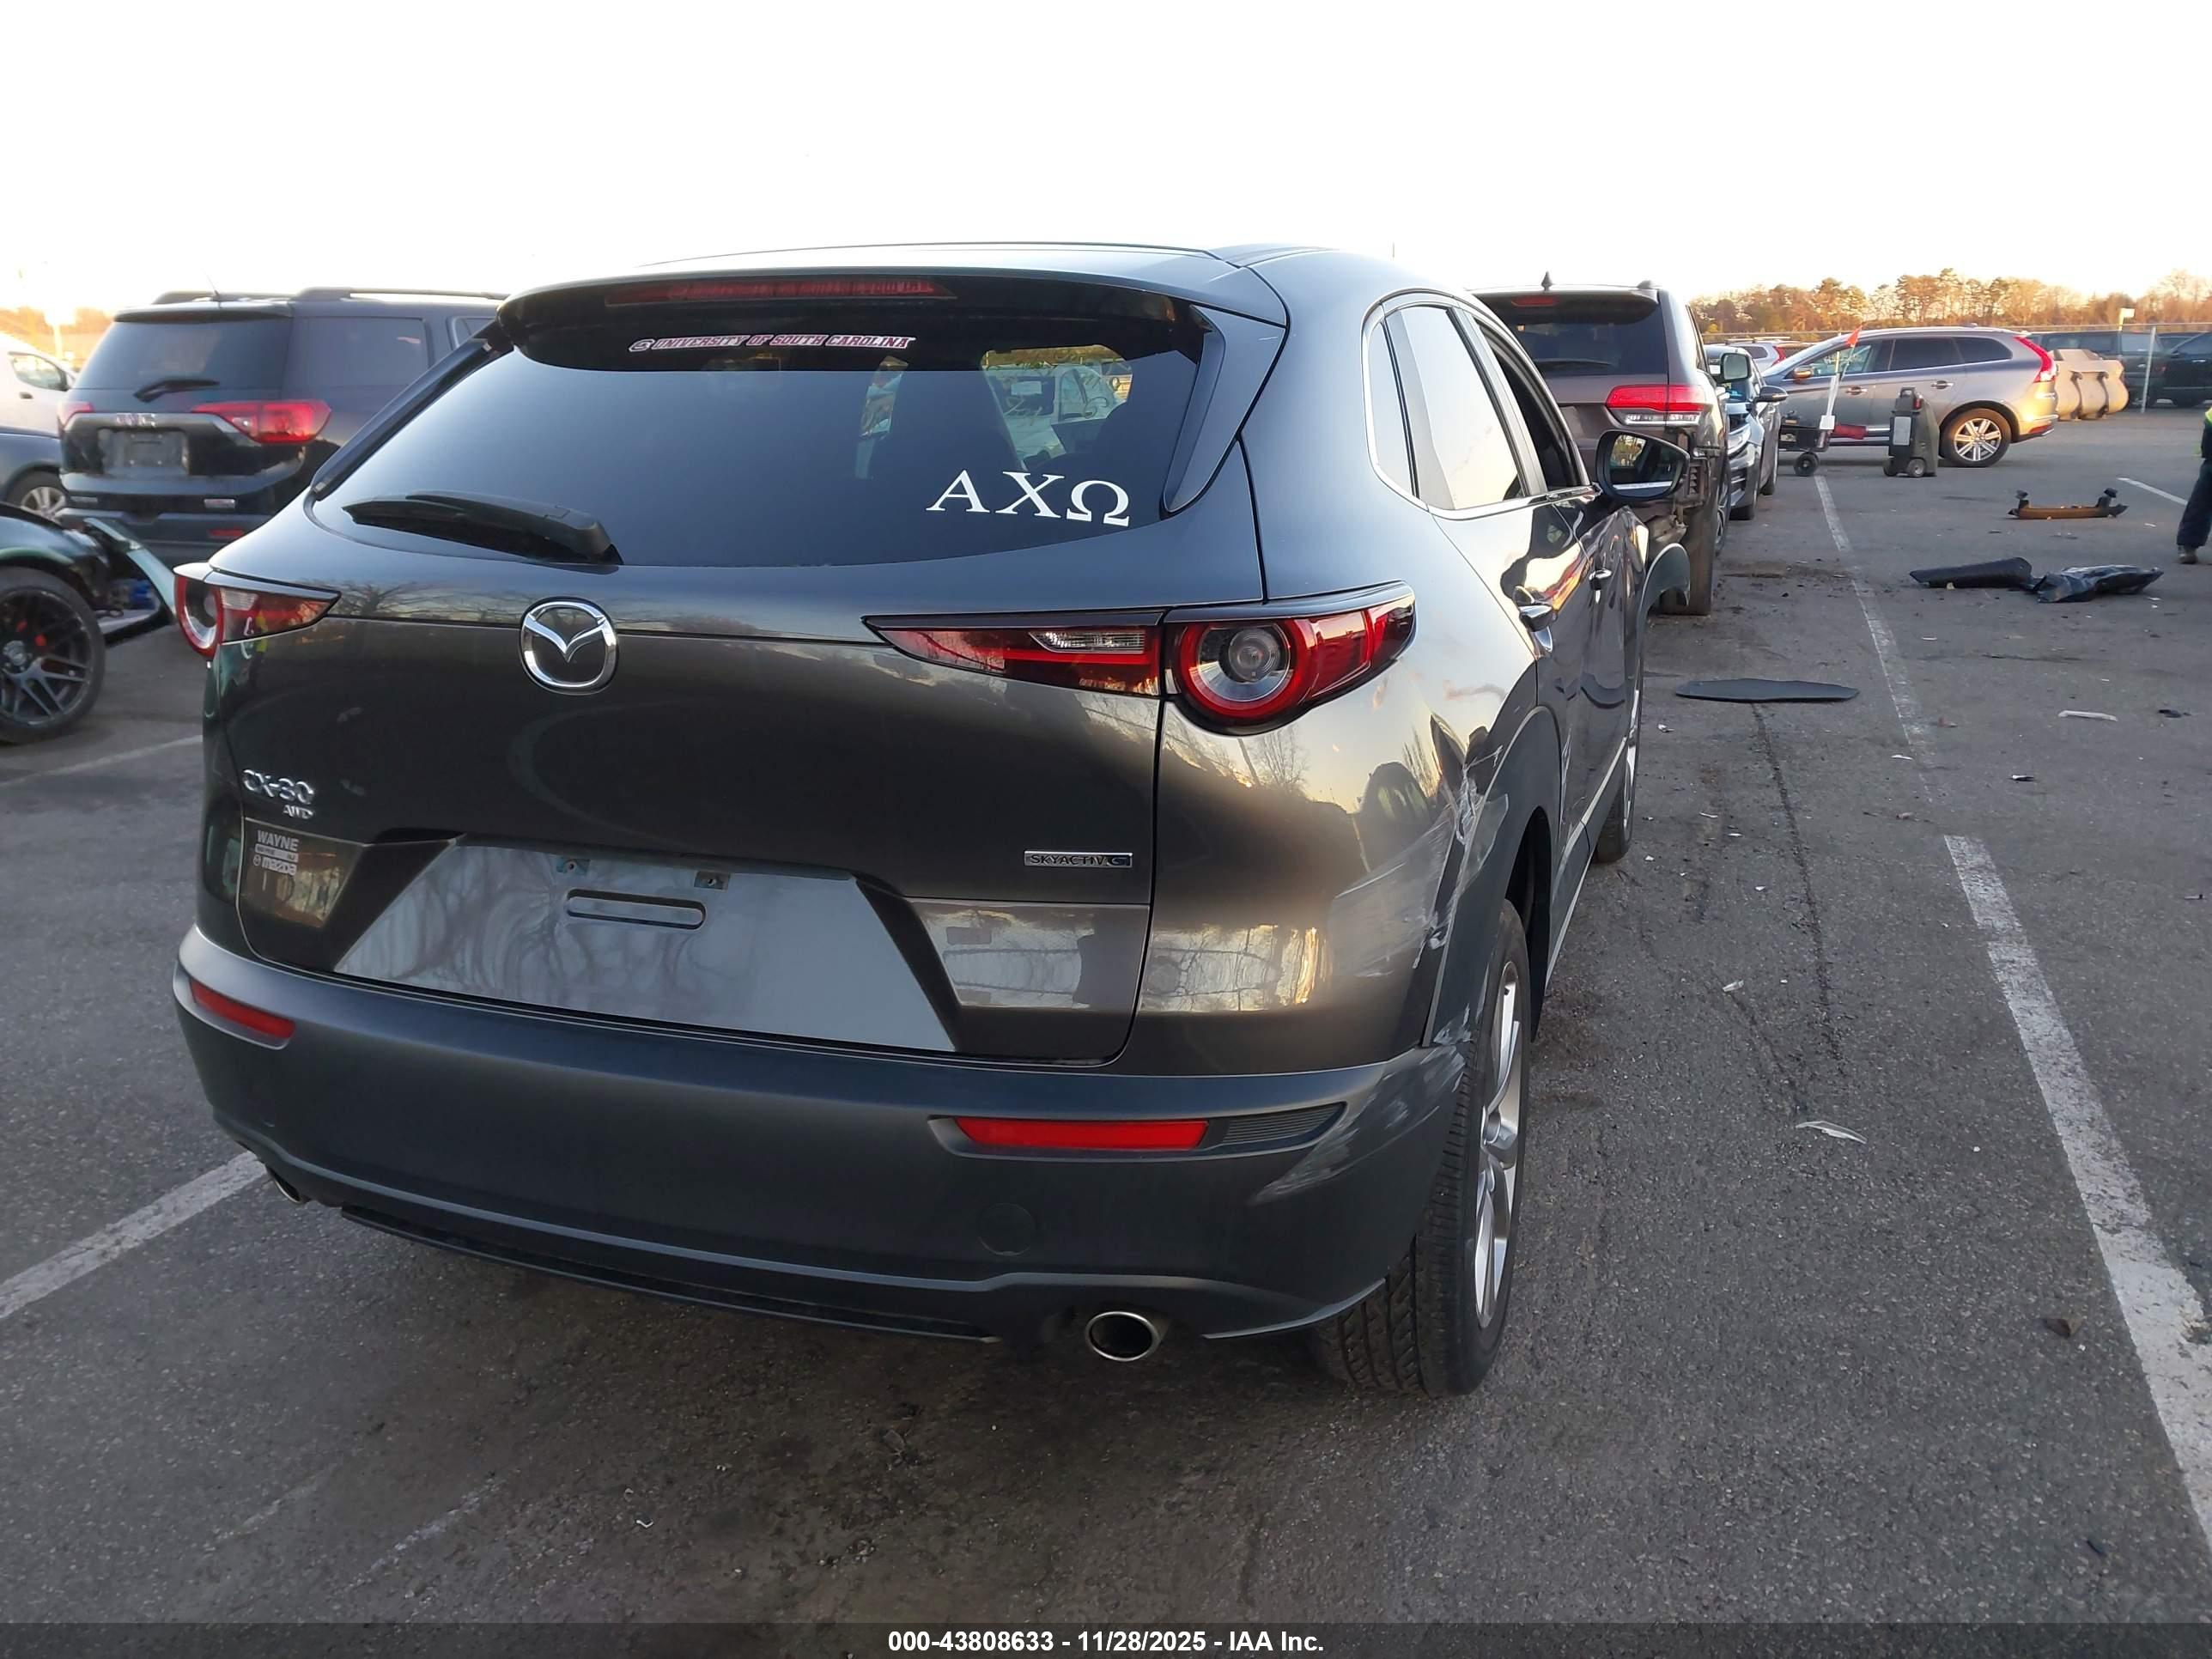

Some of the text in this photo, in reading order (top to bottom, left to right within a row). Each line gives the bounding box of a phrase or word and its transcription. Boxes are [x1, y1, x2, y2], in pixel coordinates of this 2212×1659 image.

[652, 335, 915, 349] UNIVERSITY OF SOUTH CAROLINA
[242, 769, 314, 805] CX-30
[283, 805, 313, 819] AWD
[258, 830, 300, 852] WAYNE
[262, 857, 297, 875] mazda
